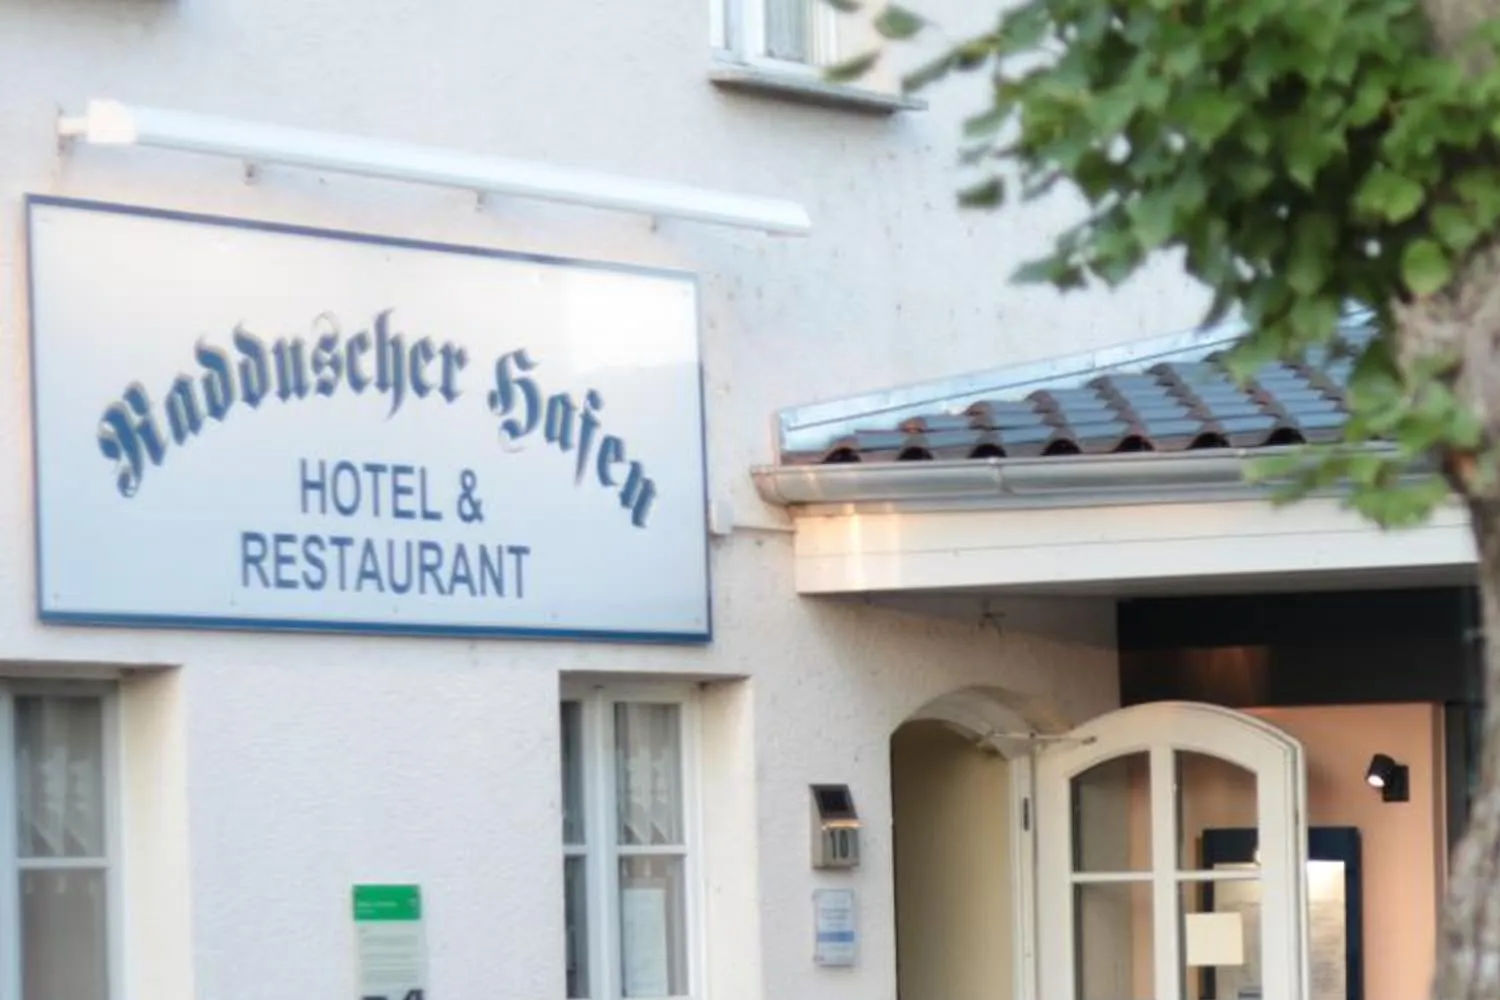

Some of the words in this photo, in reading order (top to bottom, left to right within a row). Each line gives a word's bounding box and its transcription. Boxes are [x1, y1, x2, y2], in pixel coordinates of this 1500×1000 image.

[97, 308, 468, 497] Radduscher
[487, 348, 657, 528] Hafen
[301, 458, 442, 521] HOTEL
[457, 468, 484, 523] &
[241, 531, 530, 598] RESTAURANT
